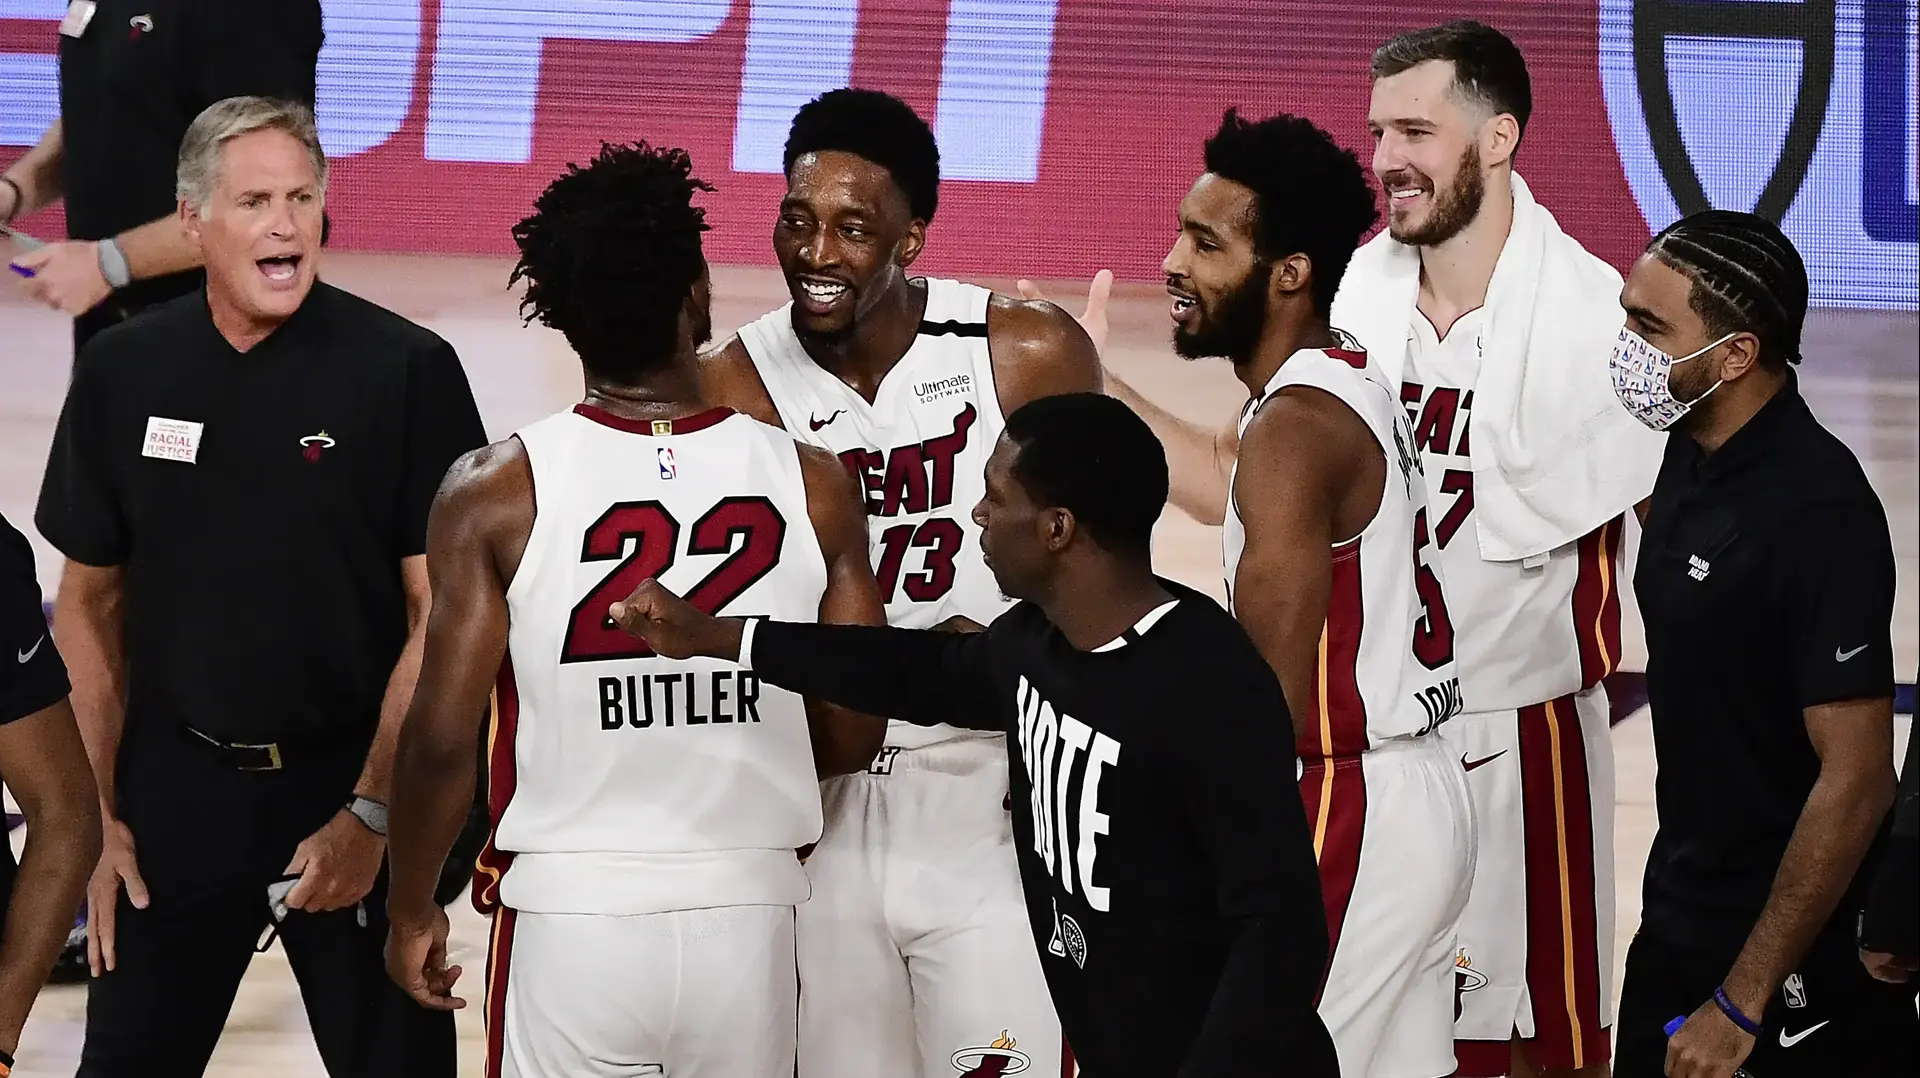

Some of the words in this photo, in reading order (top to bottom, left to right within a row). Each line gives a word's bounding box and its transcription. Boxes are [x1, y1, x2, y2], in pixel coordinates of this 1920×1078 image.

[913, 374, 970, 397] Ultimate
[920, 385, 971, 404] SOFTWARE
[146, 444, 193, 461] JUSTICE
[149, 432, 191, 448] RACIAL
[559, 495, 788, 665] 22
[876, 517, 965, 604] 13
[598, 670, 762, 731] BUTLER
[1016, 674, 1122, 912] VOTE
